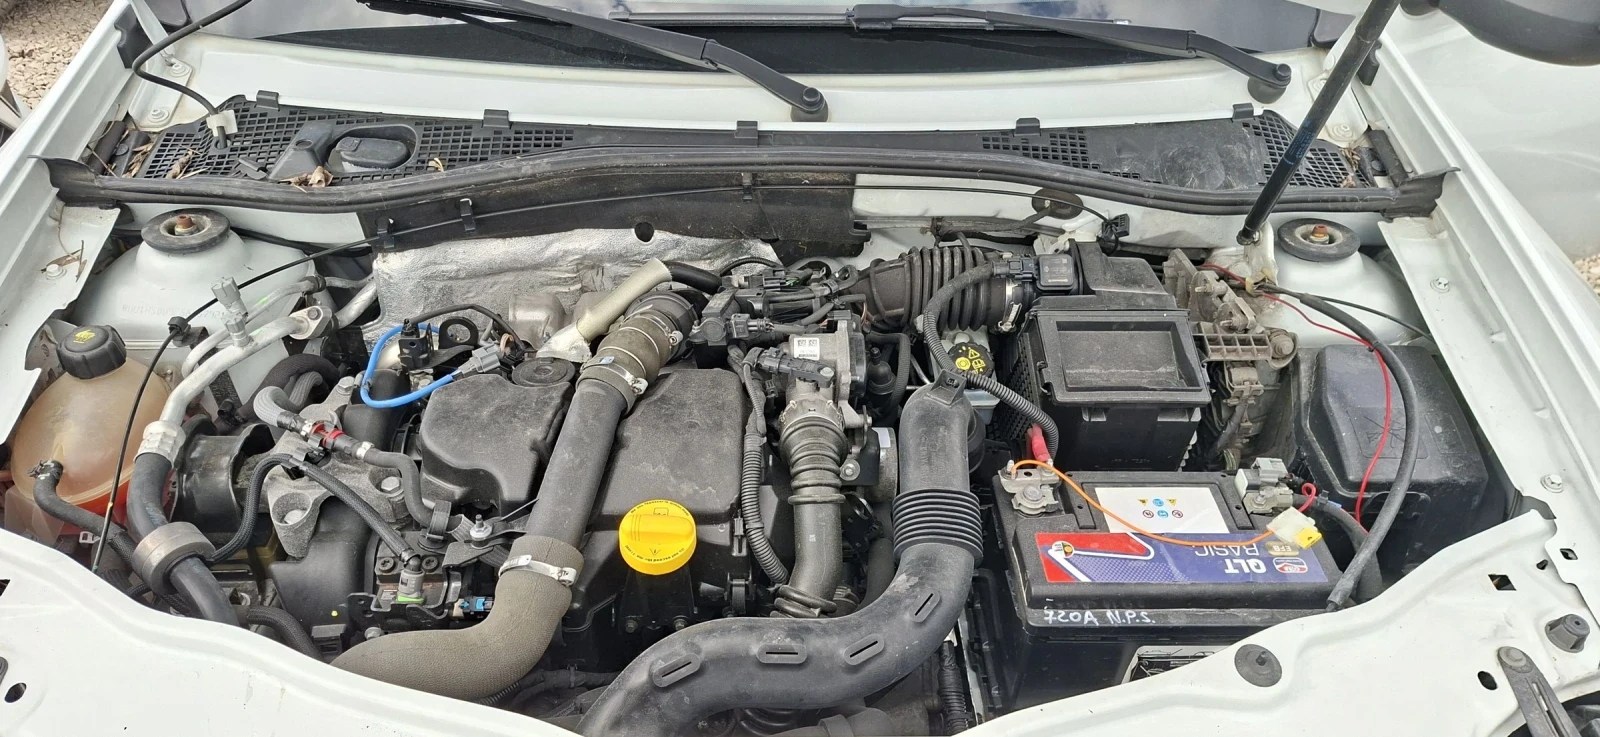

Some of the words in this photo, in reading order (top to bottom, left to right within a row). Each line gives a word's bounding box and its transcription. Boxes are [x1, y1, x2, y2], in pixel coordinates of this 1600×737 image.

[1192, 542, 1260, 556] BASIC
[1224, 558, 1267, 574] QLT
[1043, 607, 1100, 626] 720A
[1106, 610, 1156, 625] N.P.S.
